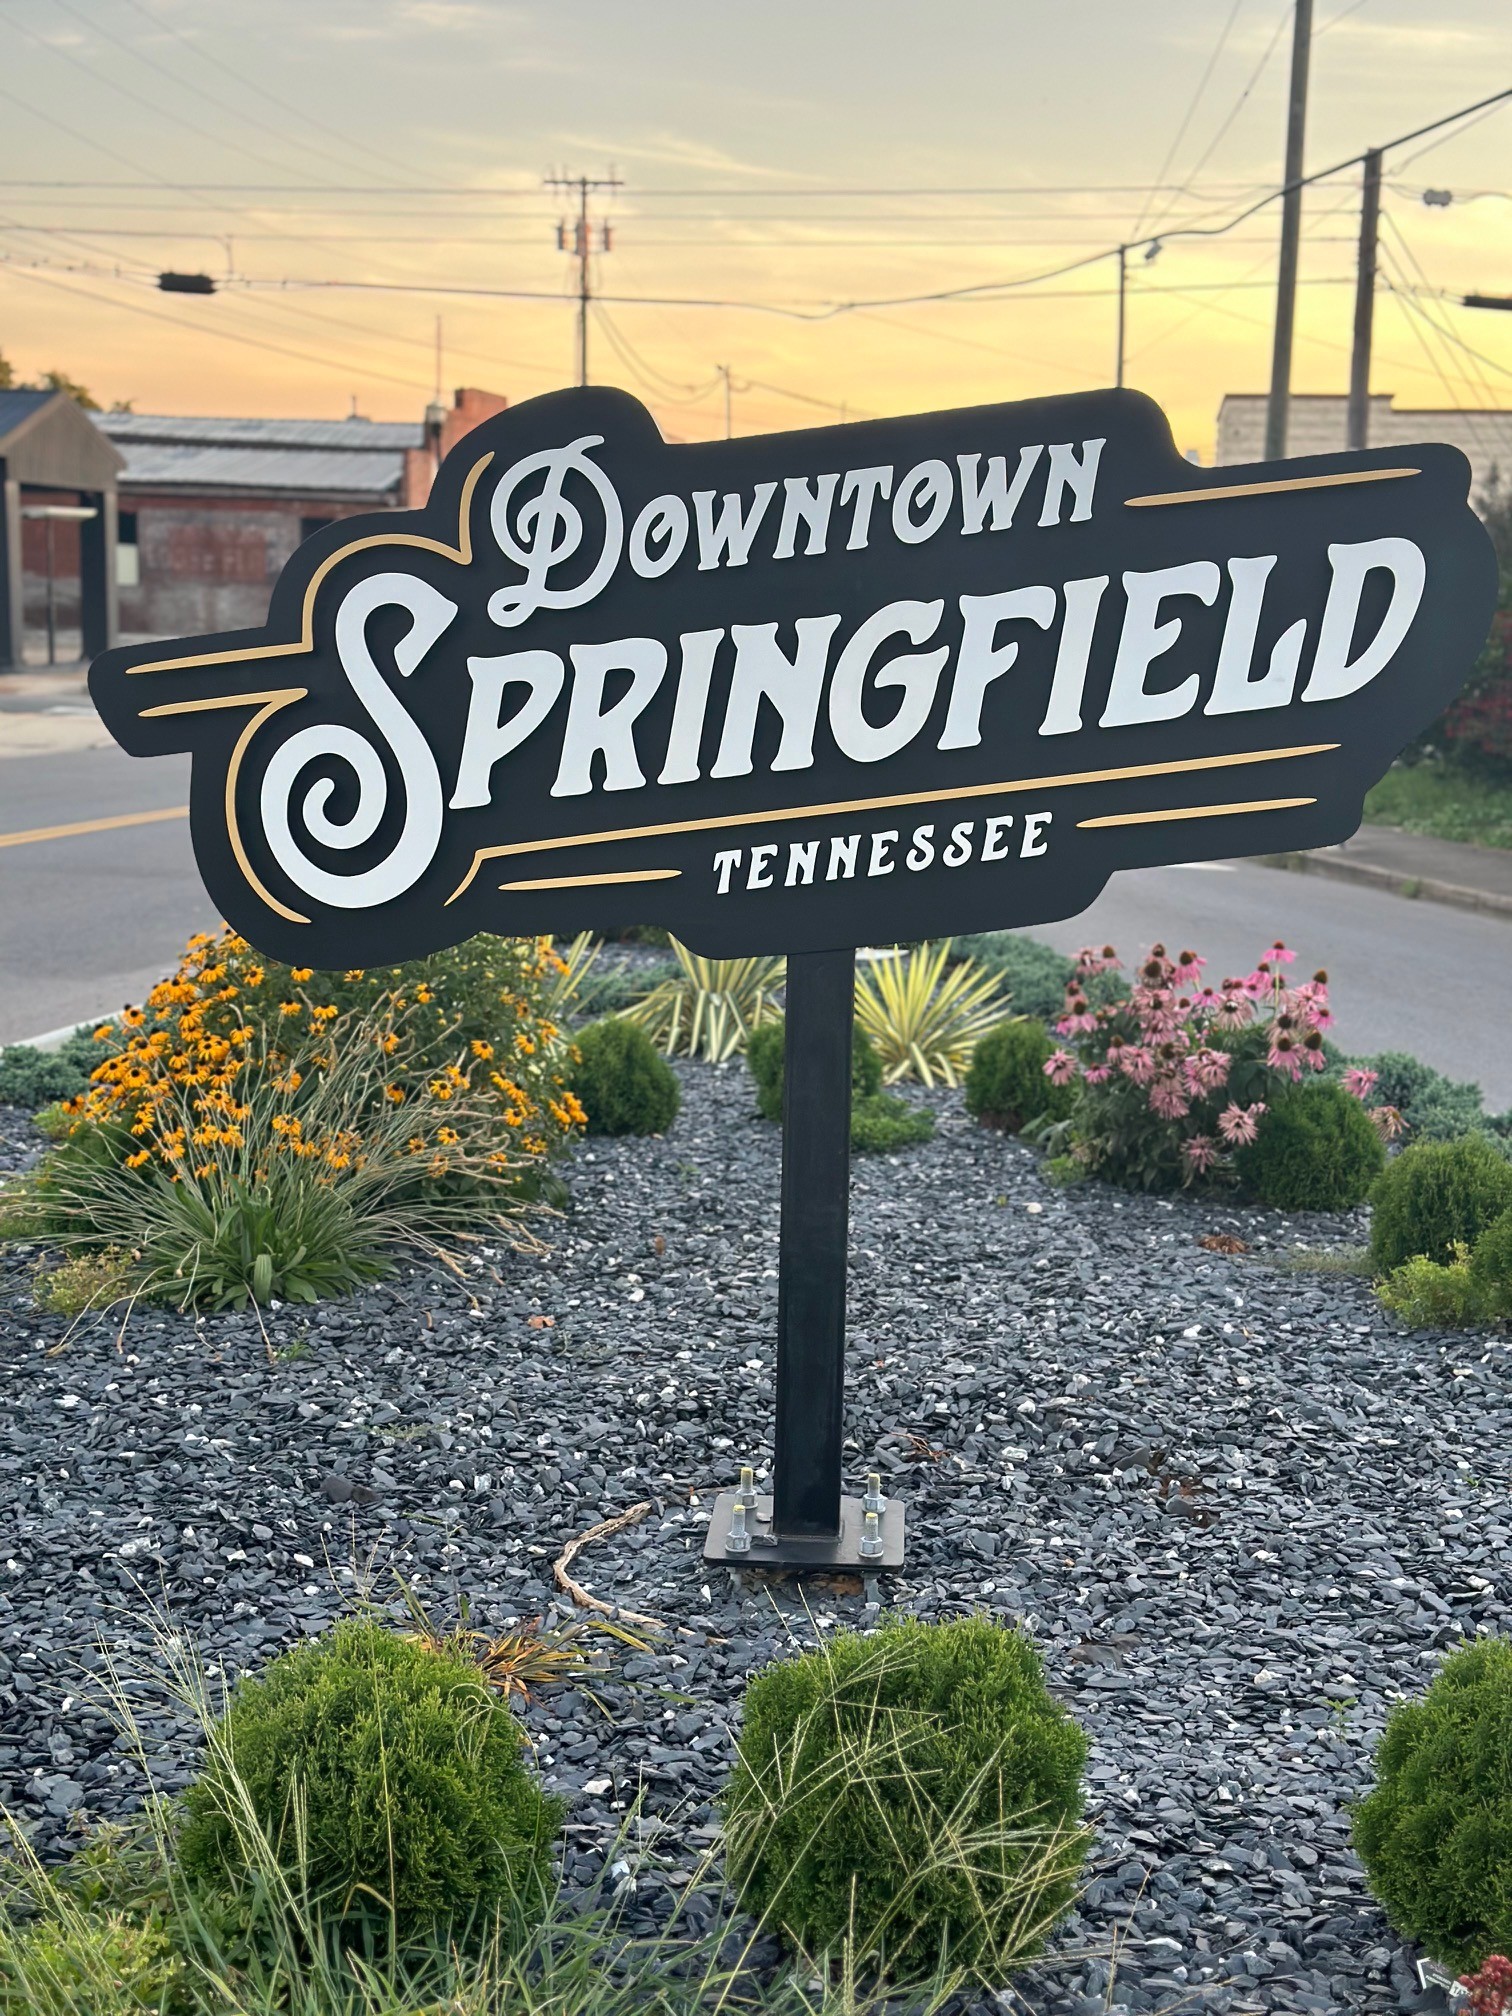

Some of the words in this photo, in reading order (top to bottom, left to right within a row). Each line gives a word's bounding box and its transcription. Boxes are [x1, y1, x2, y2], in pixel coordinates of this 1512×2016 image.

[486, 435, 1107, 628] DOWNTOWN
[260, 537, 1427, 909] SPRINGFIELD
[712, 811, 1054, 895] TENNESSEE
